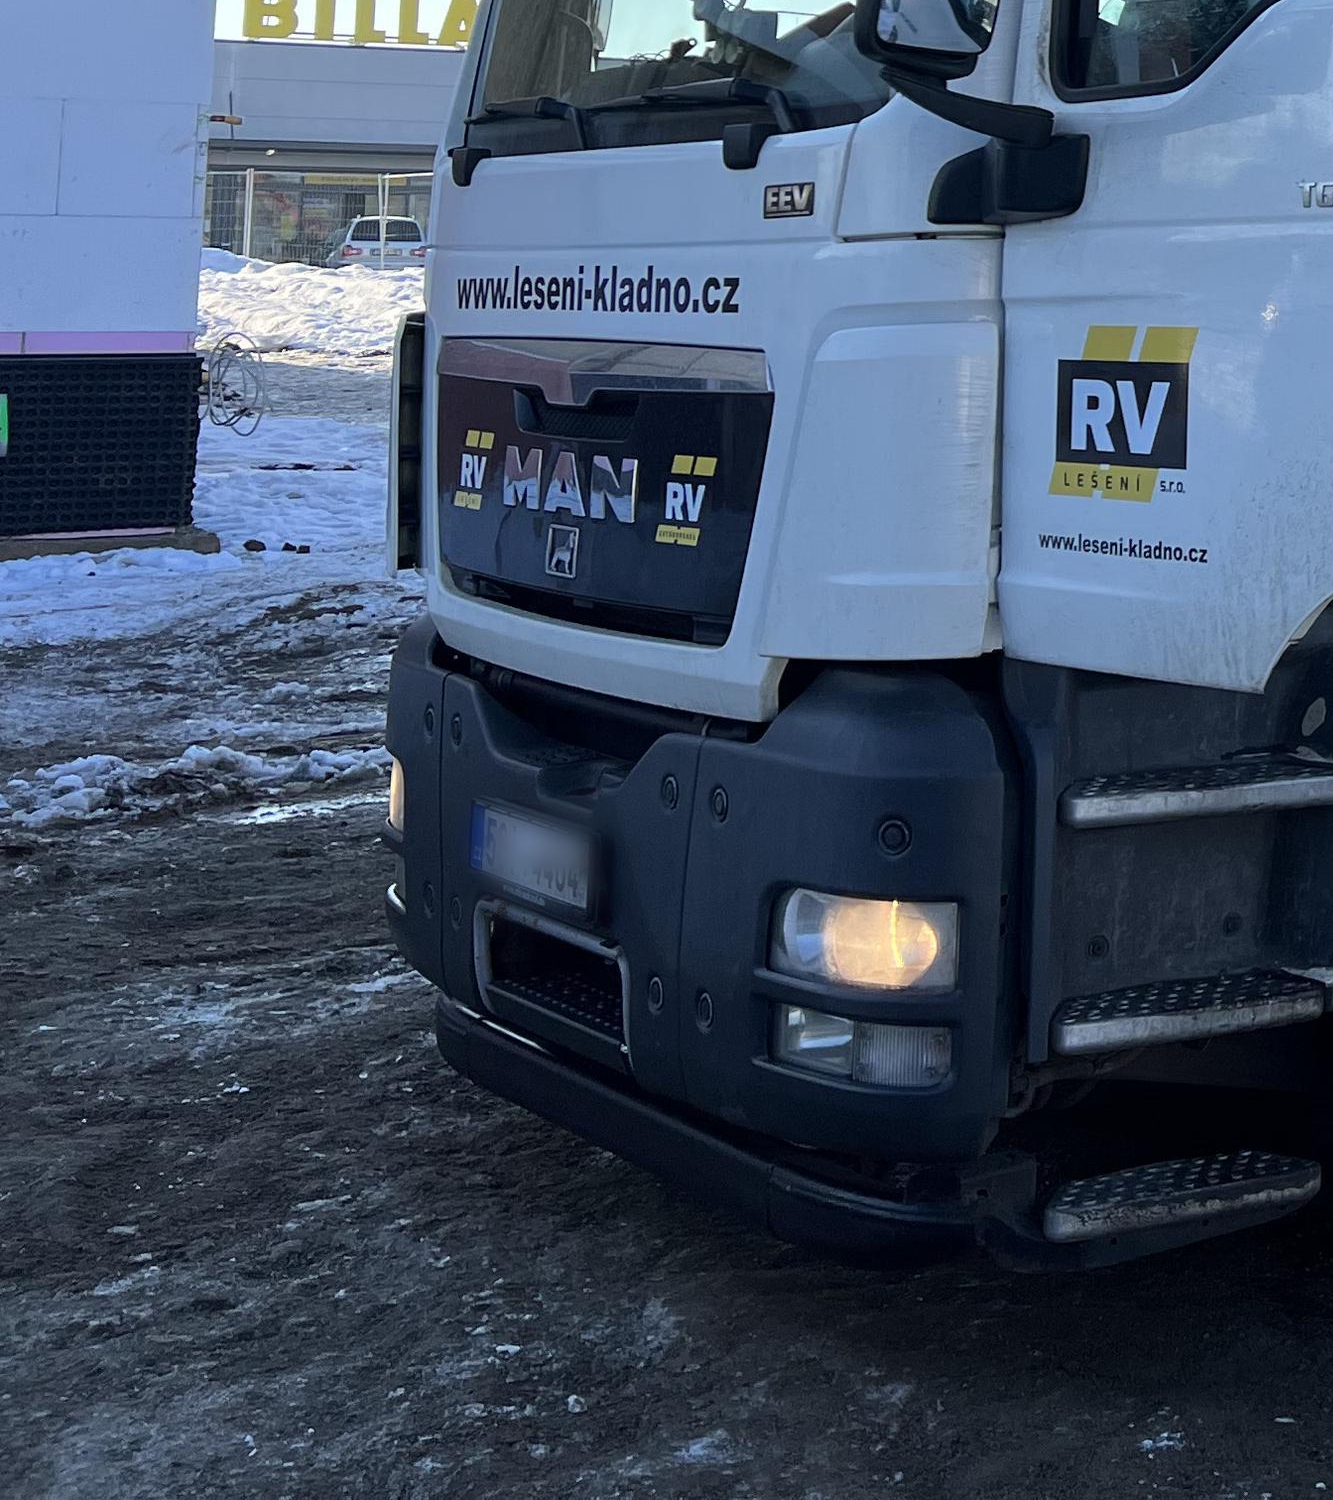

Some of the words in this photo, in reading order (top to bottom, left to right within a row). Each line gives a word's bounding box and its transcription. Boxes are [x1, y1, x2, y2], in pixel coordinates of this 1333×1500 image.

[765, 186, 813, 213] EEV
[456, 265, 741, 314] www.leseni-kladno.cz
[1071, 378, 1171, 455] RV
[459, 453, 488, 489] RV
[502, 445, 639, 524] MAN
[1063, 471, 1142, 492] LEŠENÍ
[1160, 480, 1186, 493] s.r.o.
[664, 481, 706, 522] RV
[1039, 533, 1208, 563] www.leseni-kladno.cz
